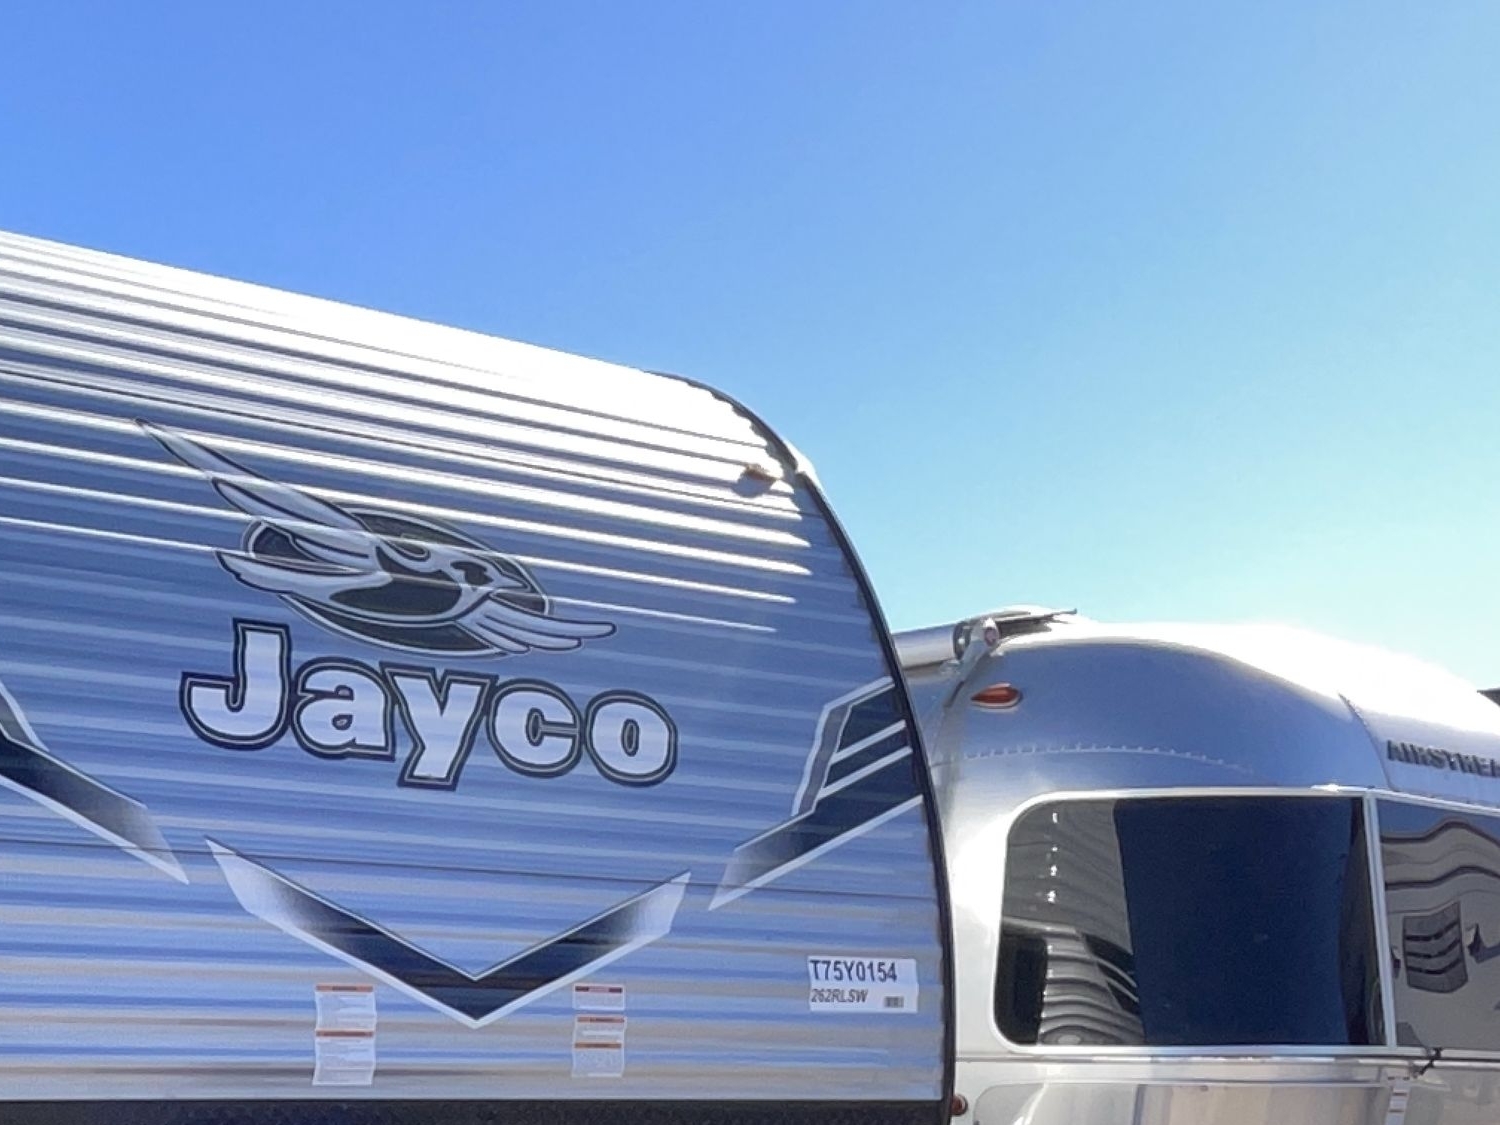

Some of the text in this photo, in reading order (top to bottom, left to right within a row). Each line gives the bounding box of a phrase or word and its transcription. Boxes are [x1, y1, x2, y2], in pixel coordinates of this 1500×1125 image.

[179, 617, 679, 791] Jayco
[810, 960, 898, 983] T75Y0154
[811, 988, 868, 1004] 262RLSW
